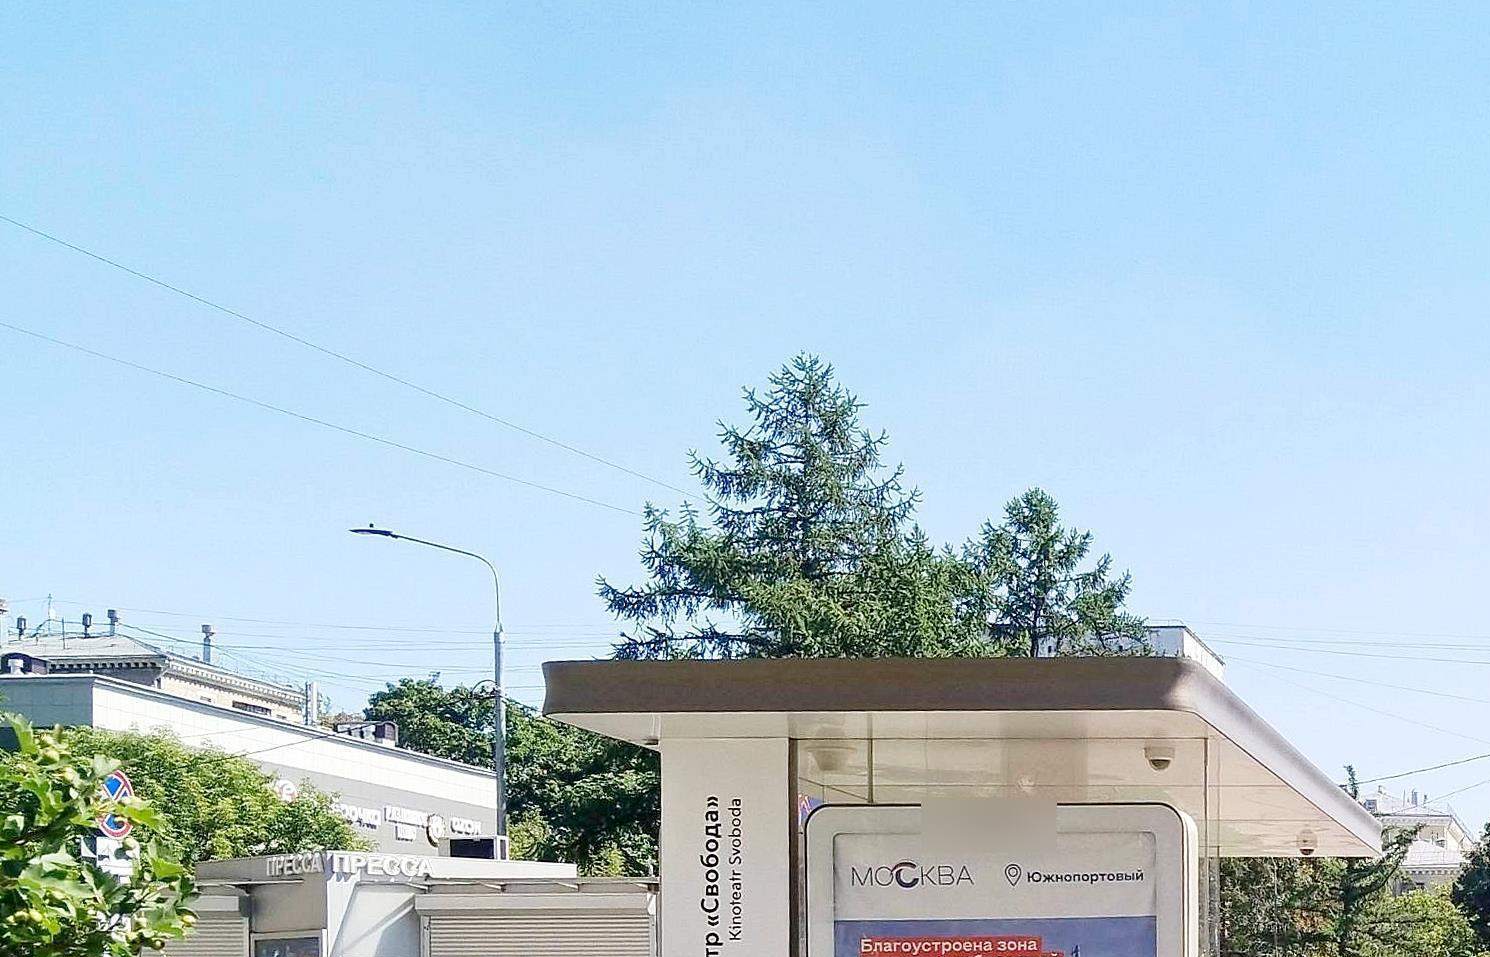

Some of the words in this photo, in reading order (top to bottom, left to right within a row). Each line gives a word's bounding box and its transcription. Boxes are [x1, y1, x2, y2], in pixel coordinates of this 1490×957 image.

[728, 798, 742, 865] Svoboda
[266, 852, 324, 876] ПРЕССА
[332, 853, 433, 877] ПРЕССА
[700, 796, 721, 927] «Свобода»
[851, 859, 975, 888] МОСКВА
[1027, 869, 1144, 883] Южнопортовый
[729, 871, 742, 941] Kinoteatr
[861, 938, 992, 955] Благоустроена
[997, 940, 1038, 951] зона
